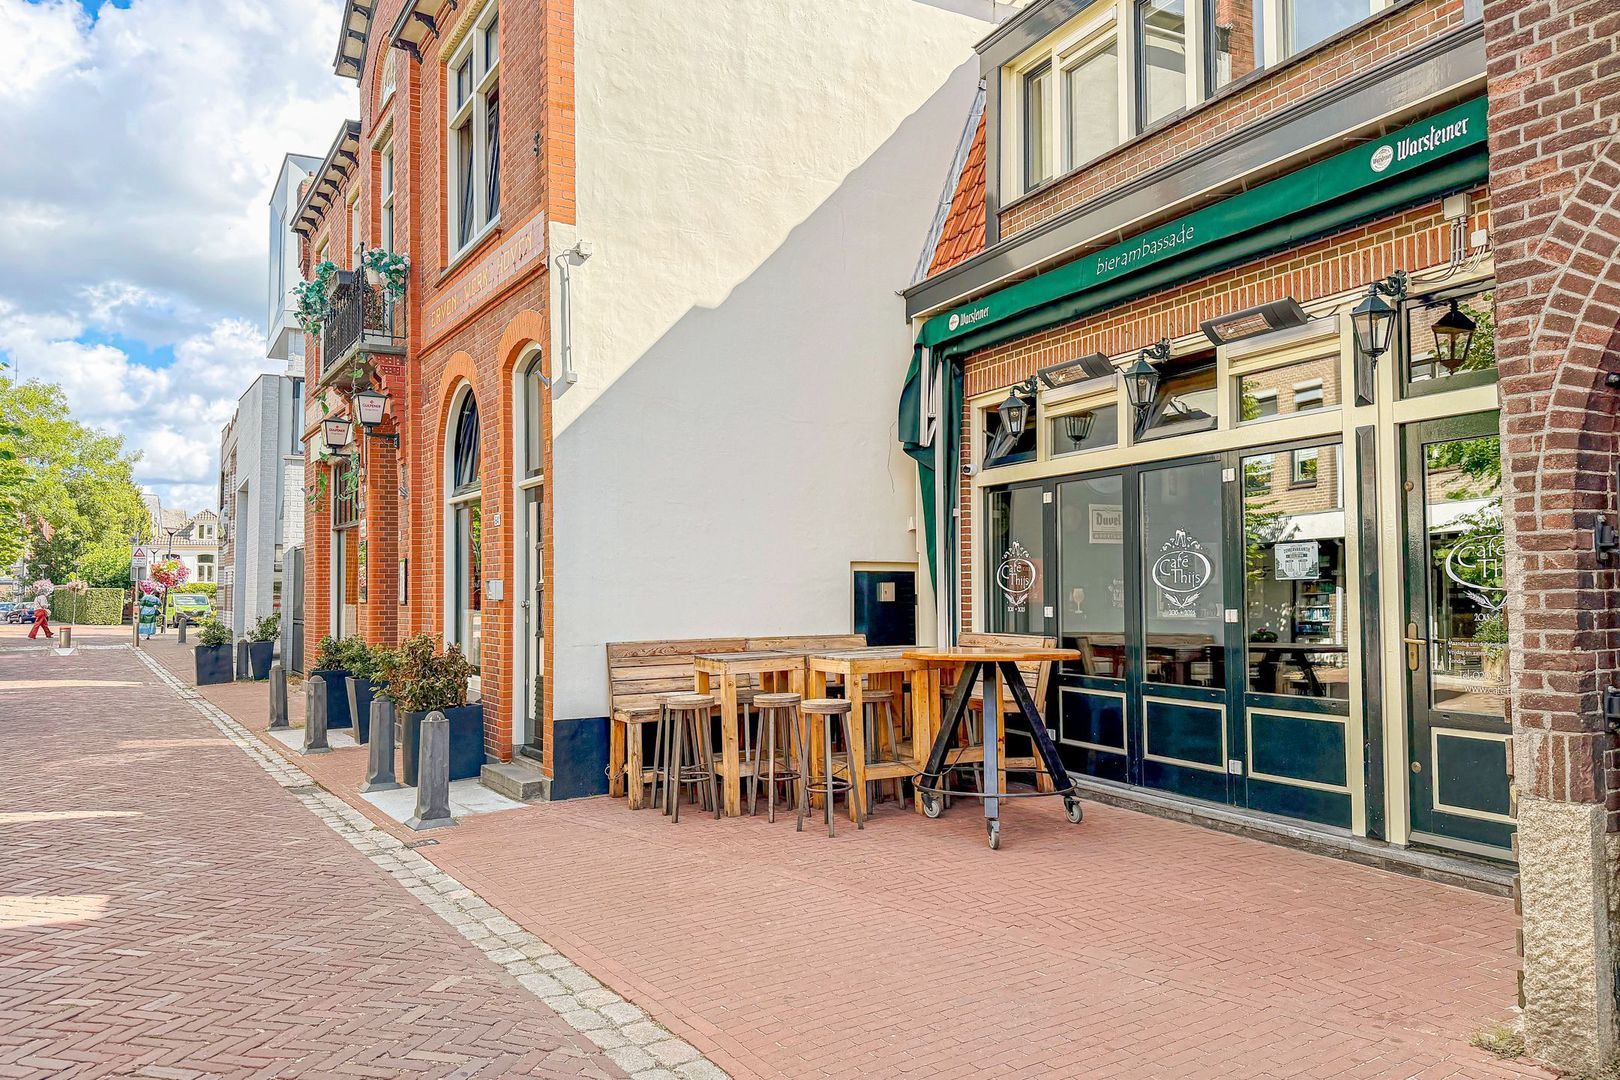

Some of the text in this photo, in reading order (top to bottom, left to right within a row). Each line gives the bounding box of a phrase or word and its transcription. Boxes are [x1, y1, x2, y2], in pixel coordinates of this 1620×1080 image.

[1397, 118, 1469, 161] Warsteiner
[1096, 224, 1194, 275] bierambassade
[1096, 512, 1121, 526] Duvel
[1001, 559, 1023, 579] Café
[1160, 551, 1189, 576] Café
[1009, 573, 1030, 589] Thijs
[1170, 568, 1201, 588] Thijs
